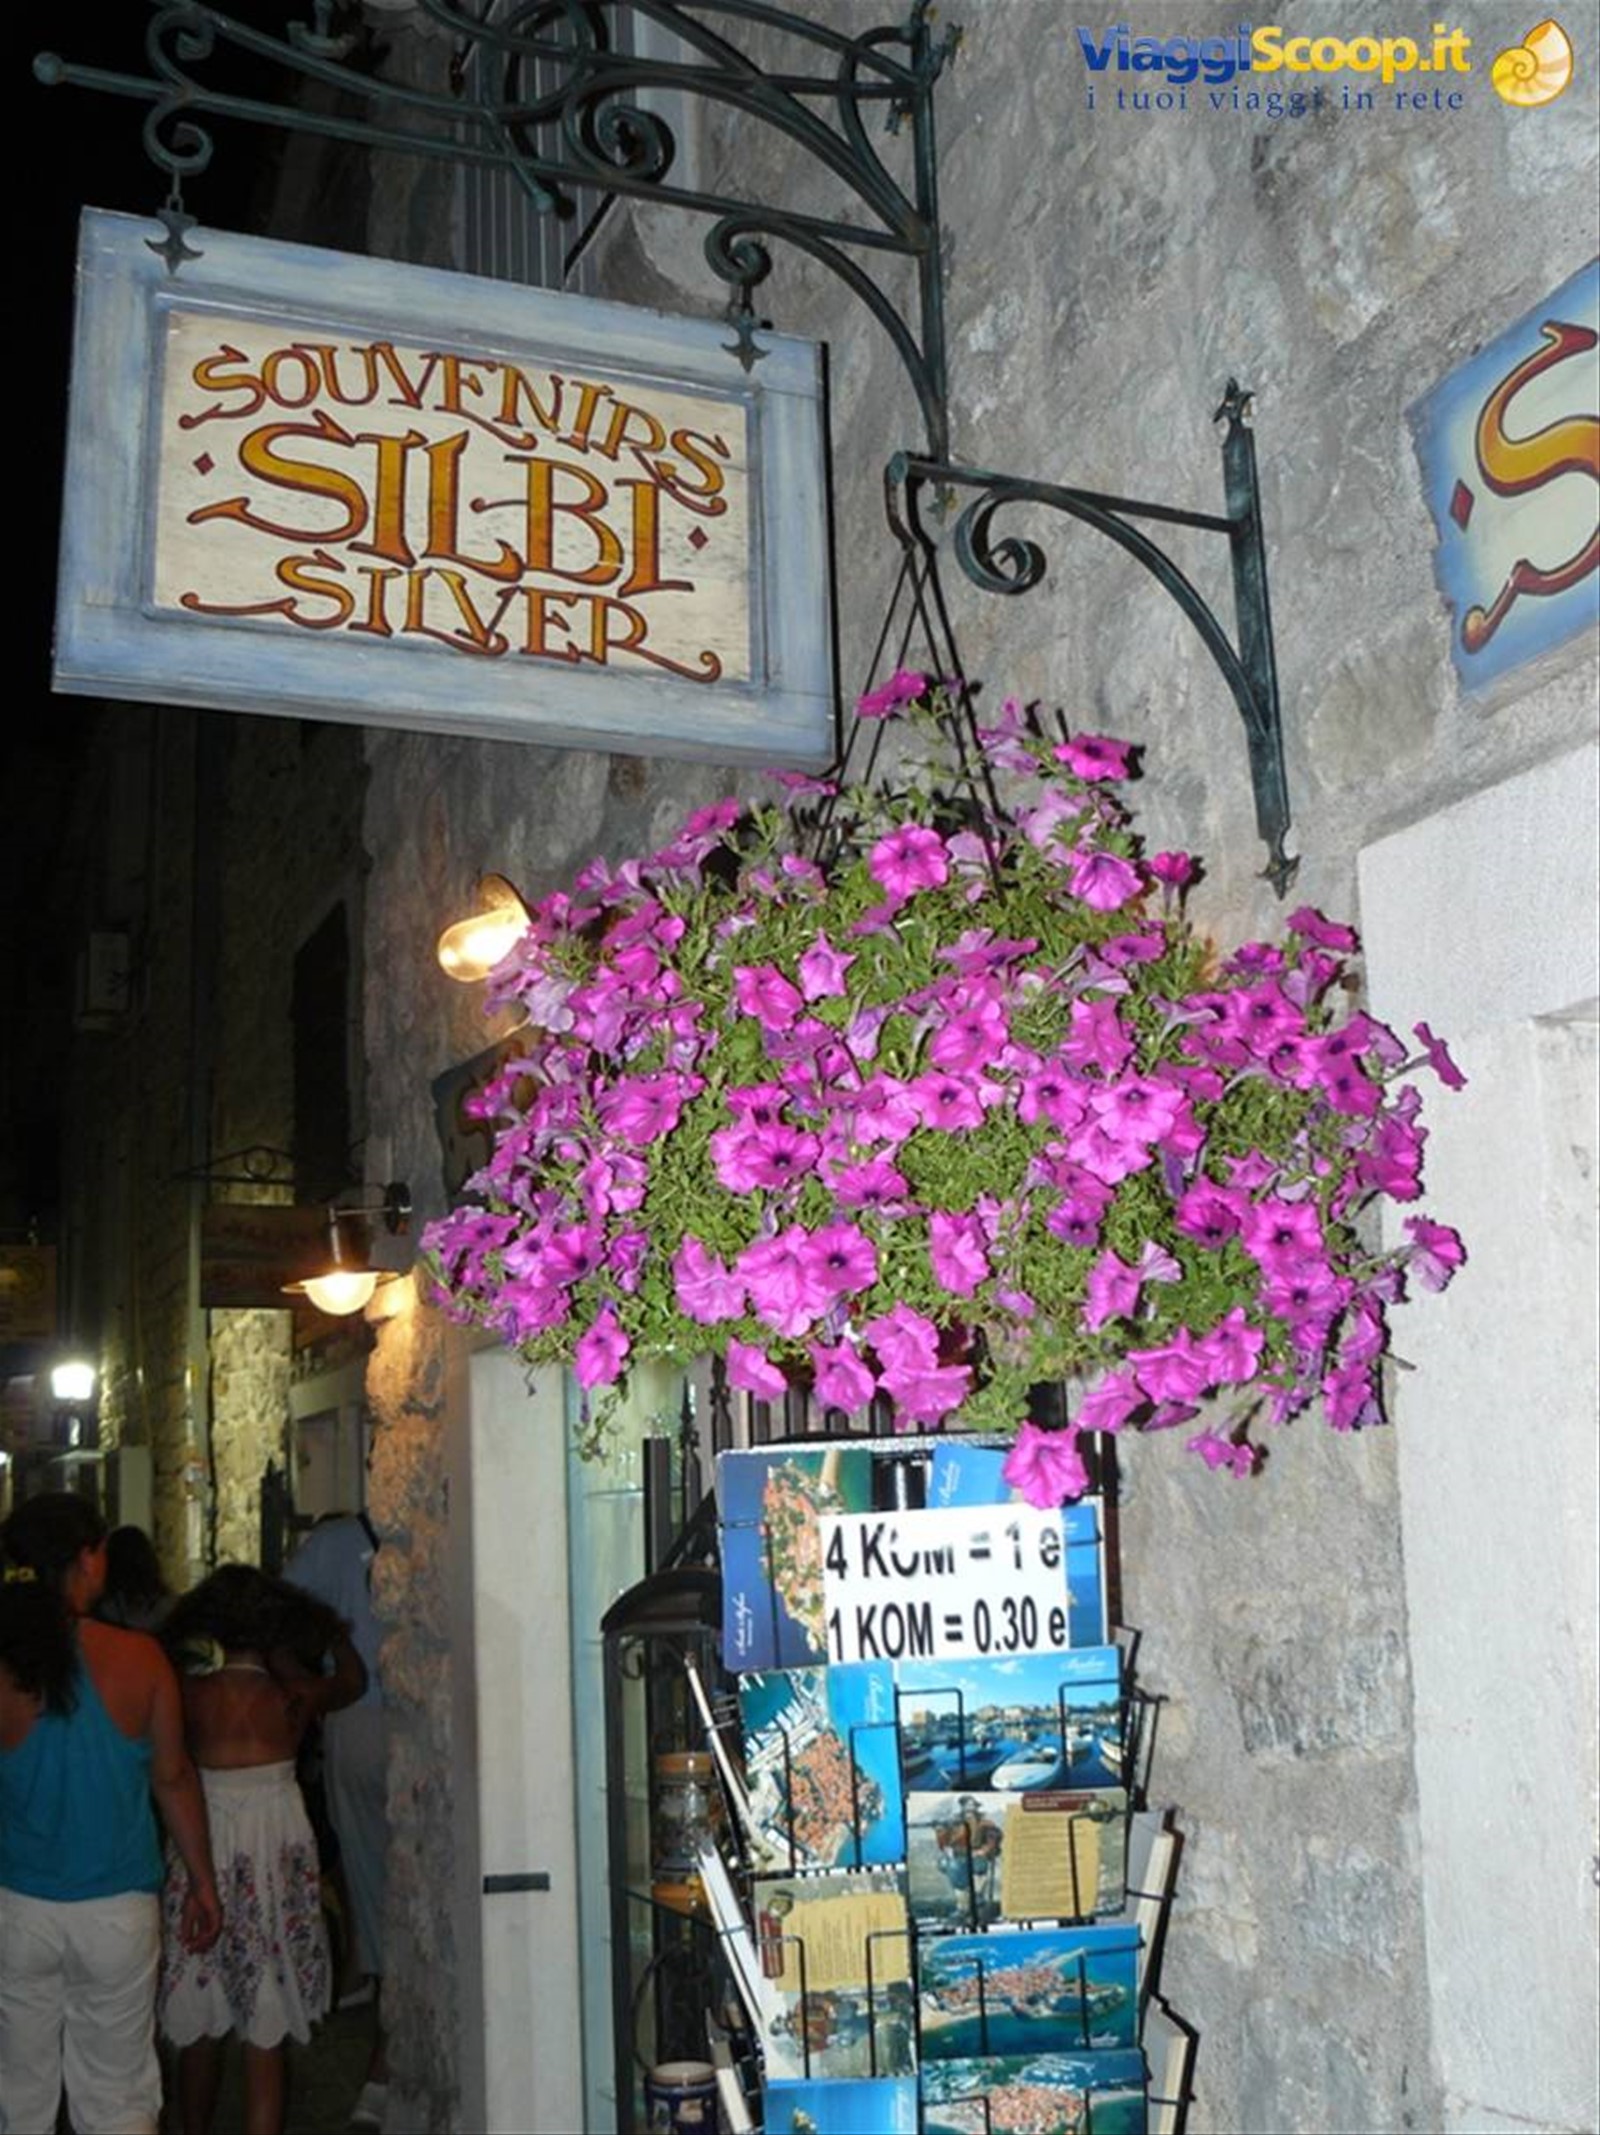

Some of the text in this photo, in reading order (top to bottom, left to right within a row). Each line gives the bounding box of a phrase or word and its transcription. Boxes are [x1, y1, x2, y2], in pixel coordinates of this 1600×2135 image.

[179, 342, 731, 516] SOUVENIRS
[187, 410, 695, 598] SILBI
[180, 549, 722, 683] SILVER
[826, 1524, 848, 1580] 4
[1005, 1521, 1022, 1571] 1
[1039, 1527, 1061, 1569] e
[829, 1595, 1066, 1663] 1 KOM = 0.30 e
